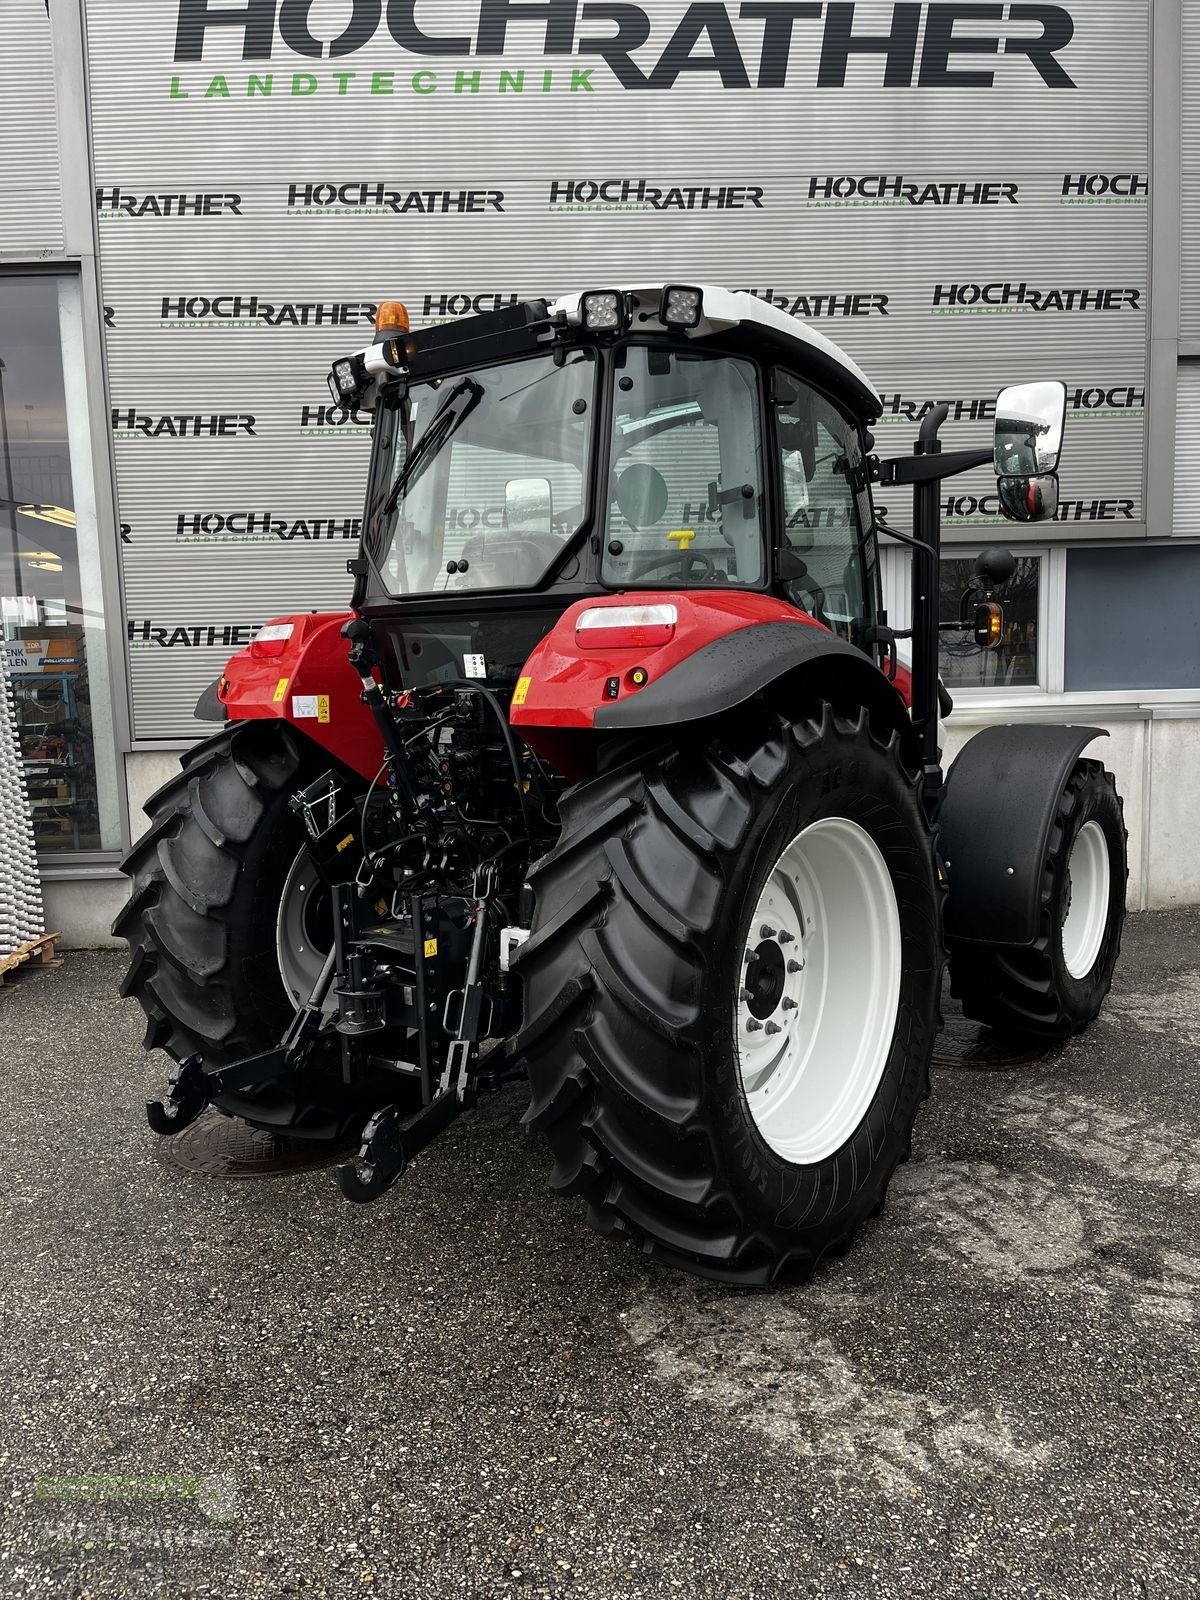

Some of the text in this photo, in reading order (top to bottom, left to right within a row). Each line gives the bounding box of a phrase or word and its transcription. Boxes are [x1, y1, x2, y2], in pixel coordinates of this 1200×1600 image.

[169, 69, 596, 98] LANDTECHNIK
[549, 180, 764, 210] HOCHRATHER
[808, 176, 1018, 205] HOCHRATHER
[288, 183, 505, 213] HOCHRATHER
[548, 203, 650, 212] LANDTECHNIK
[806, 199, 907, 208] LANDTECHNIK
[287, 207, 389, 215] LANDTECHNIK
[932, 283, 1140, 311] HOCHRATHER
[931, 305, 1031, 314] LANDTECHNIK
[160, 320, 263, 328] LANDTECHNIK
[176, 535, 275, 543] LANDTECHNIK
